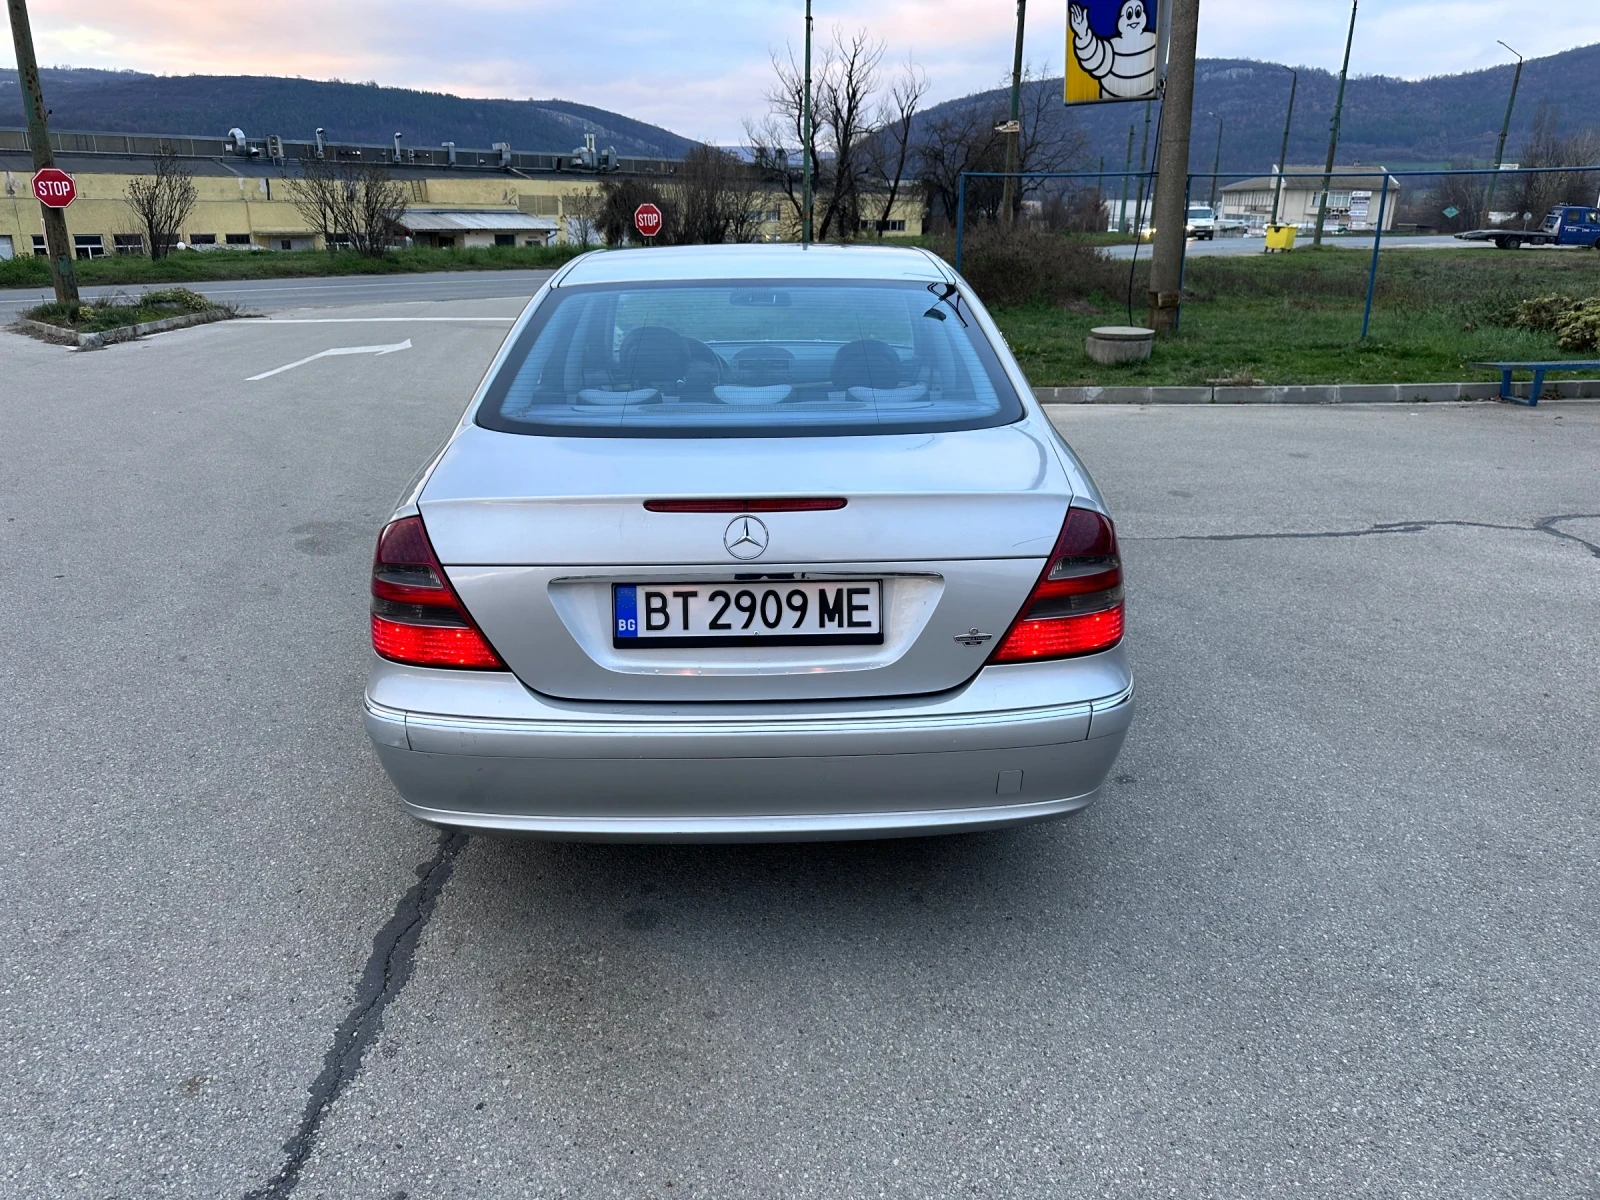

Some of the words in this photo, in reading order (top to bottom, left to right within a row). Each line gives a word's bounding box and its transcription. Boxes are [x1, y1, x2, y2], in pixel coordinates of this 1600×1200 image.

[38, 181, 70, 196] STOP
[638, 213, 658, 227] STOP
[645, 591, 698, 631] BT
[708, 589, 808, 630] 2909
[818, 587, 872, 628] ME
[618, 619, 636, 631] BG
